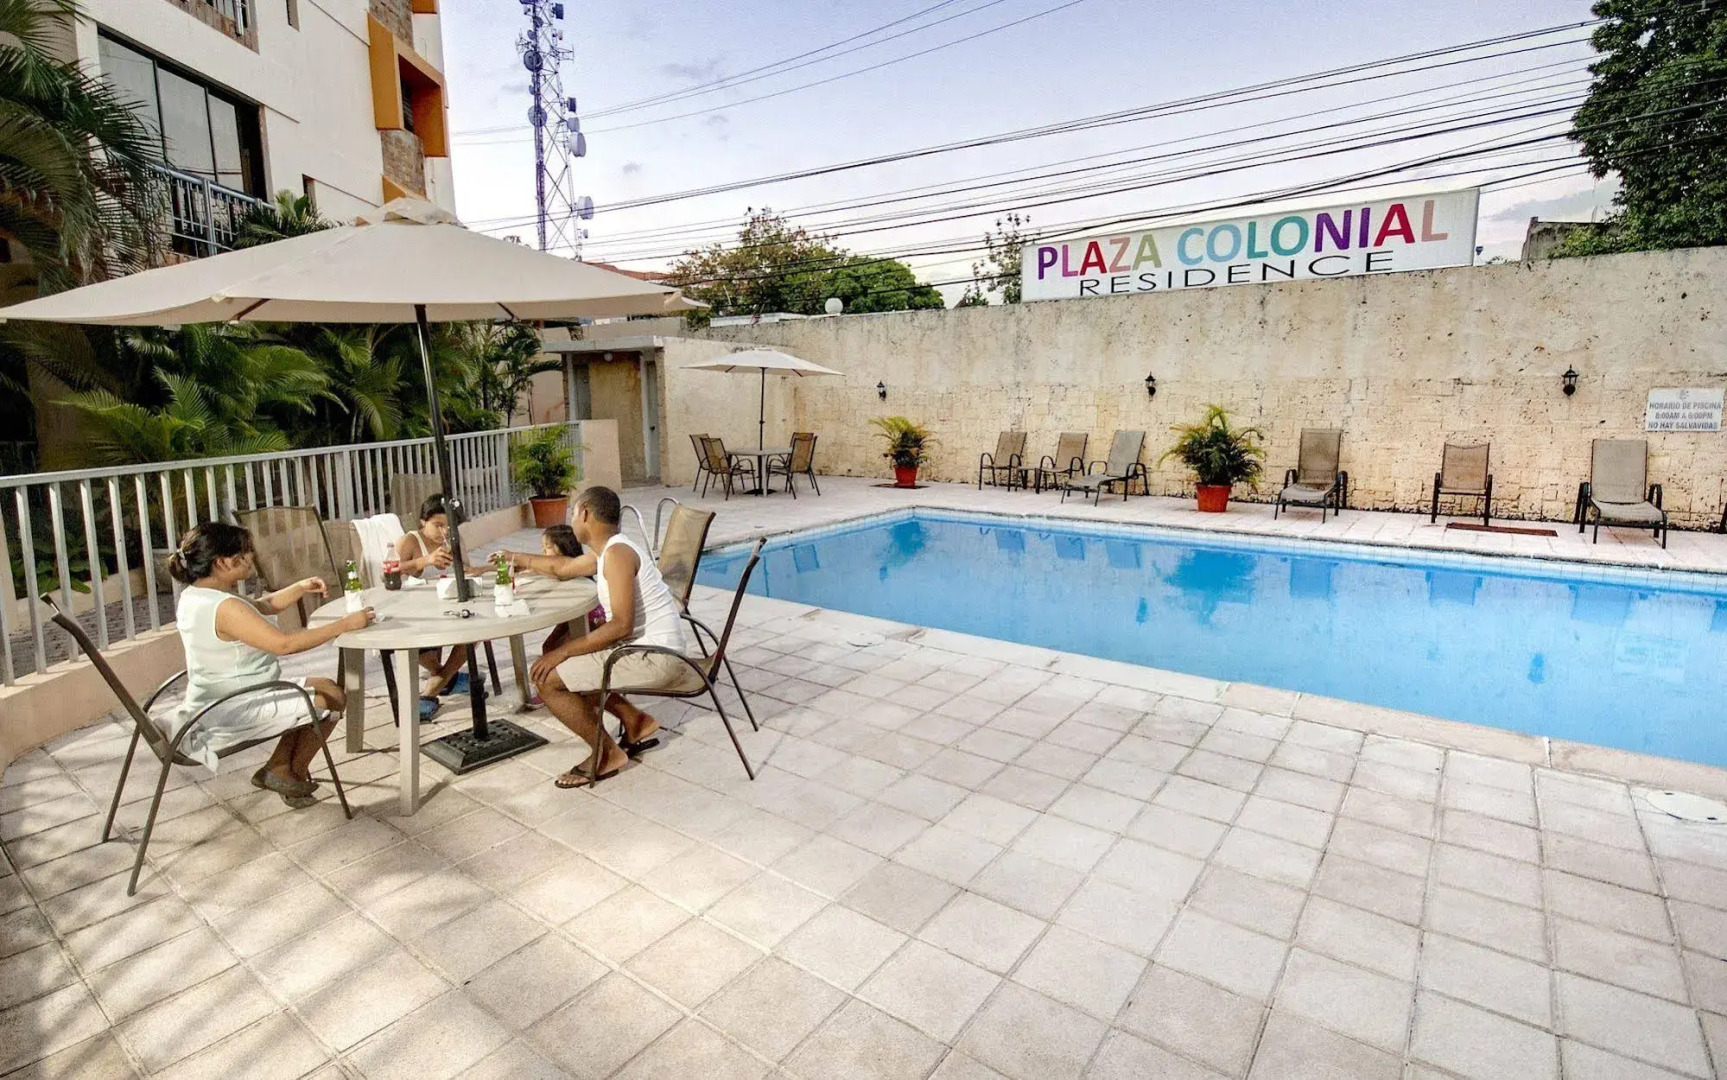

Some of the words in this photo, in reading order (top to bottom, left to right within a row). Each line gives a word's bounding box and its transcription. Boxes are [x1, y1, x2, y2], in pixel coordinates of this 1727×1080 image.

[1038, 233, 1162, 280] PLAZA
[1177, 200, 1448, 266] COLONIAL
[1080, 250, 1394, 297] RESIDENCE
[1649, 402, 1680, 410] HORARIO
[1682, 402, 1692, 410] DE
[1693, 402, 1722, 410] PISCINA
[1675, 422, 1718, 430] SALVAVIDAS
